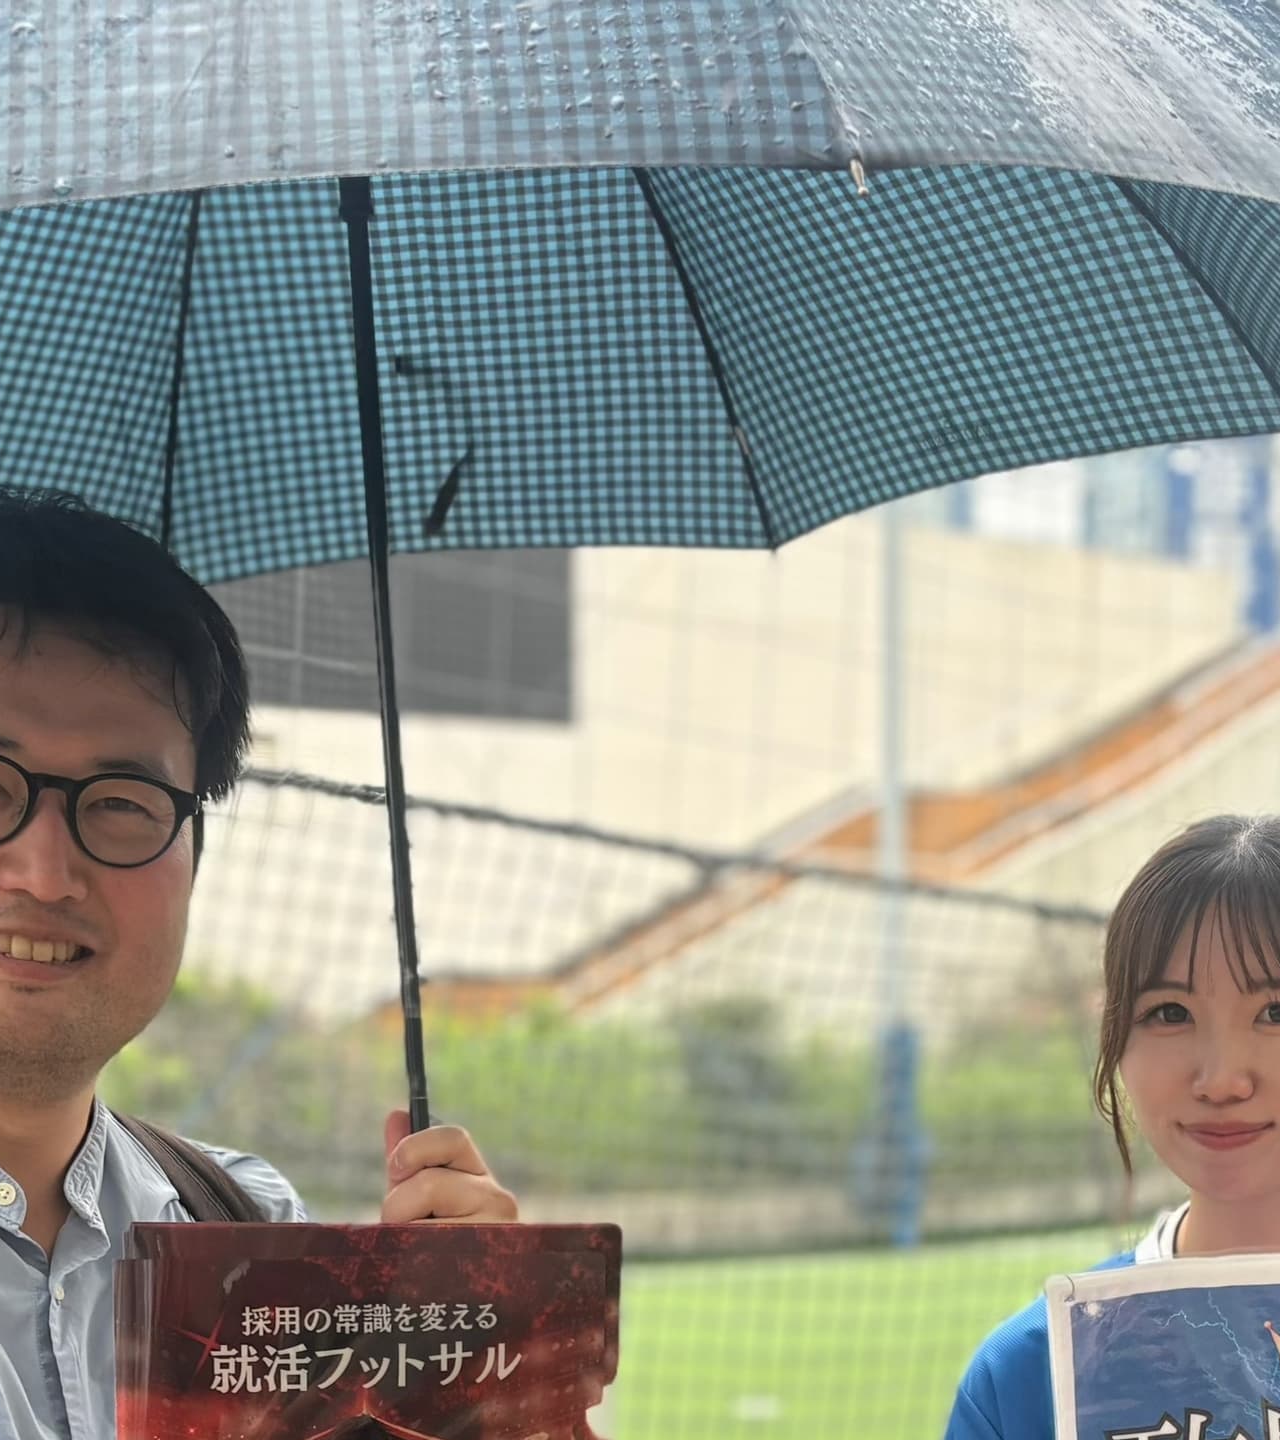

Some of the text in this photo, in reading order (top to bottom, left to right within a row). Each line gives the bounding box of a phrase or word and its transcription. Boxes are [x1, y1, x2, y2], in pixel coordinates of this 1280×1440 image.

[241, 1303, 498, 1336] 採用の常識を変える
[210, 1341, 522, 1394] 就活フットサル
